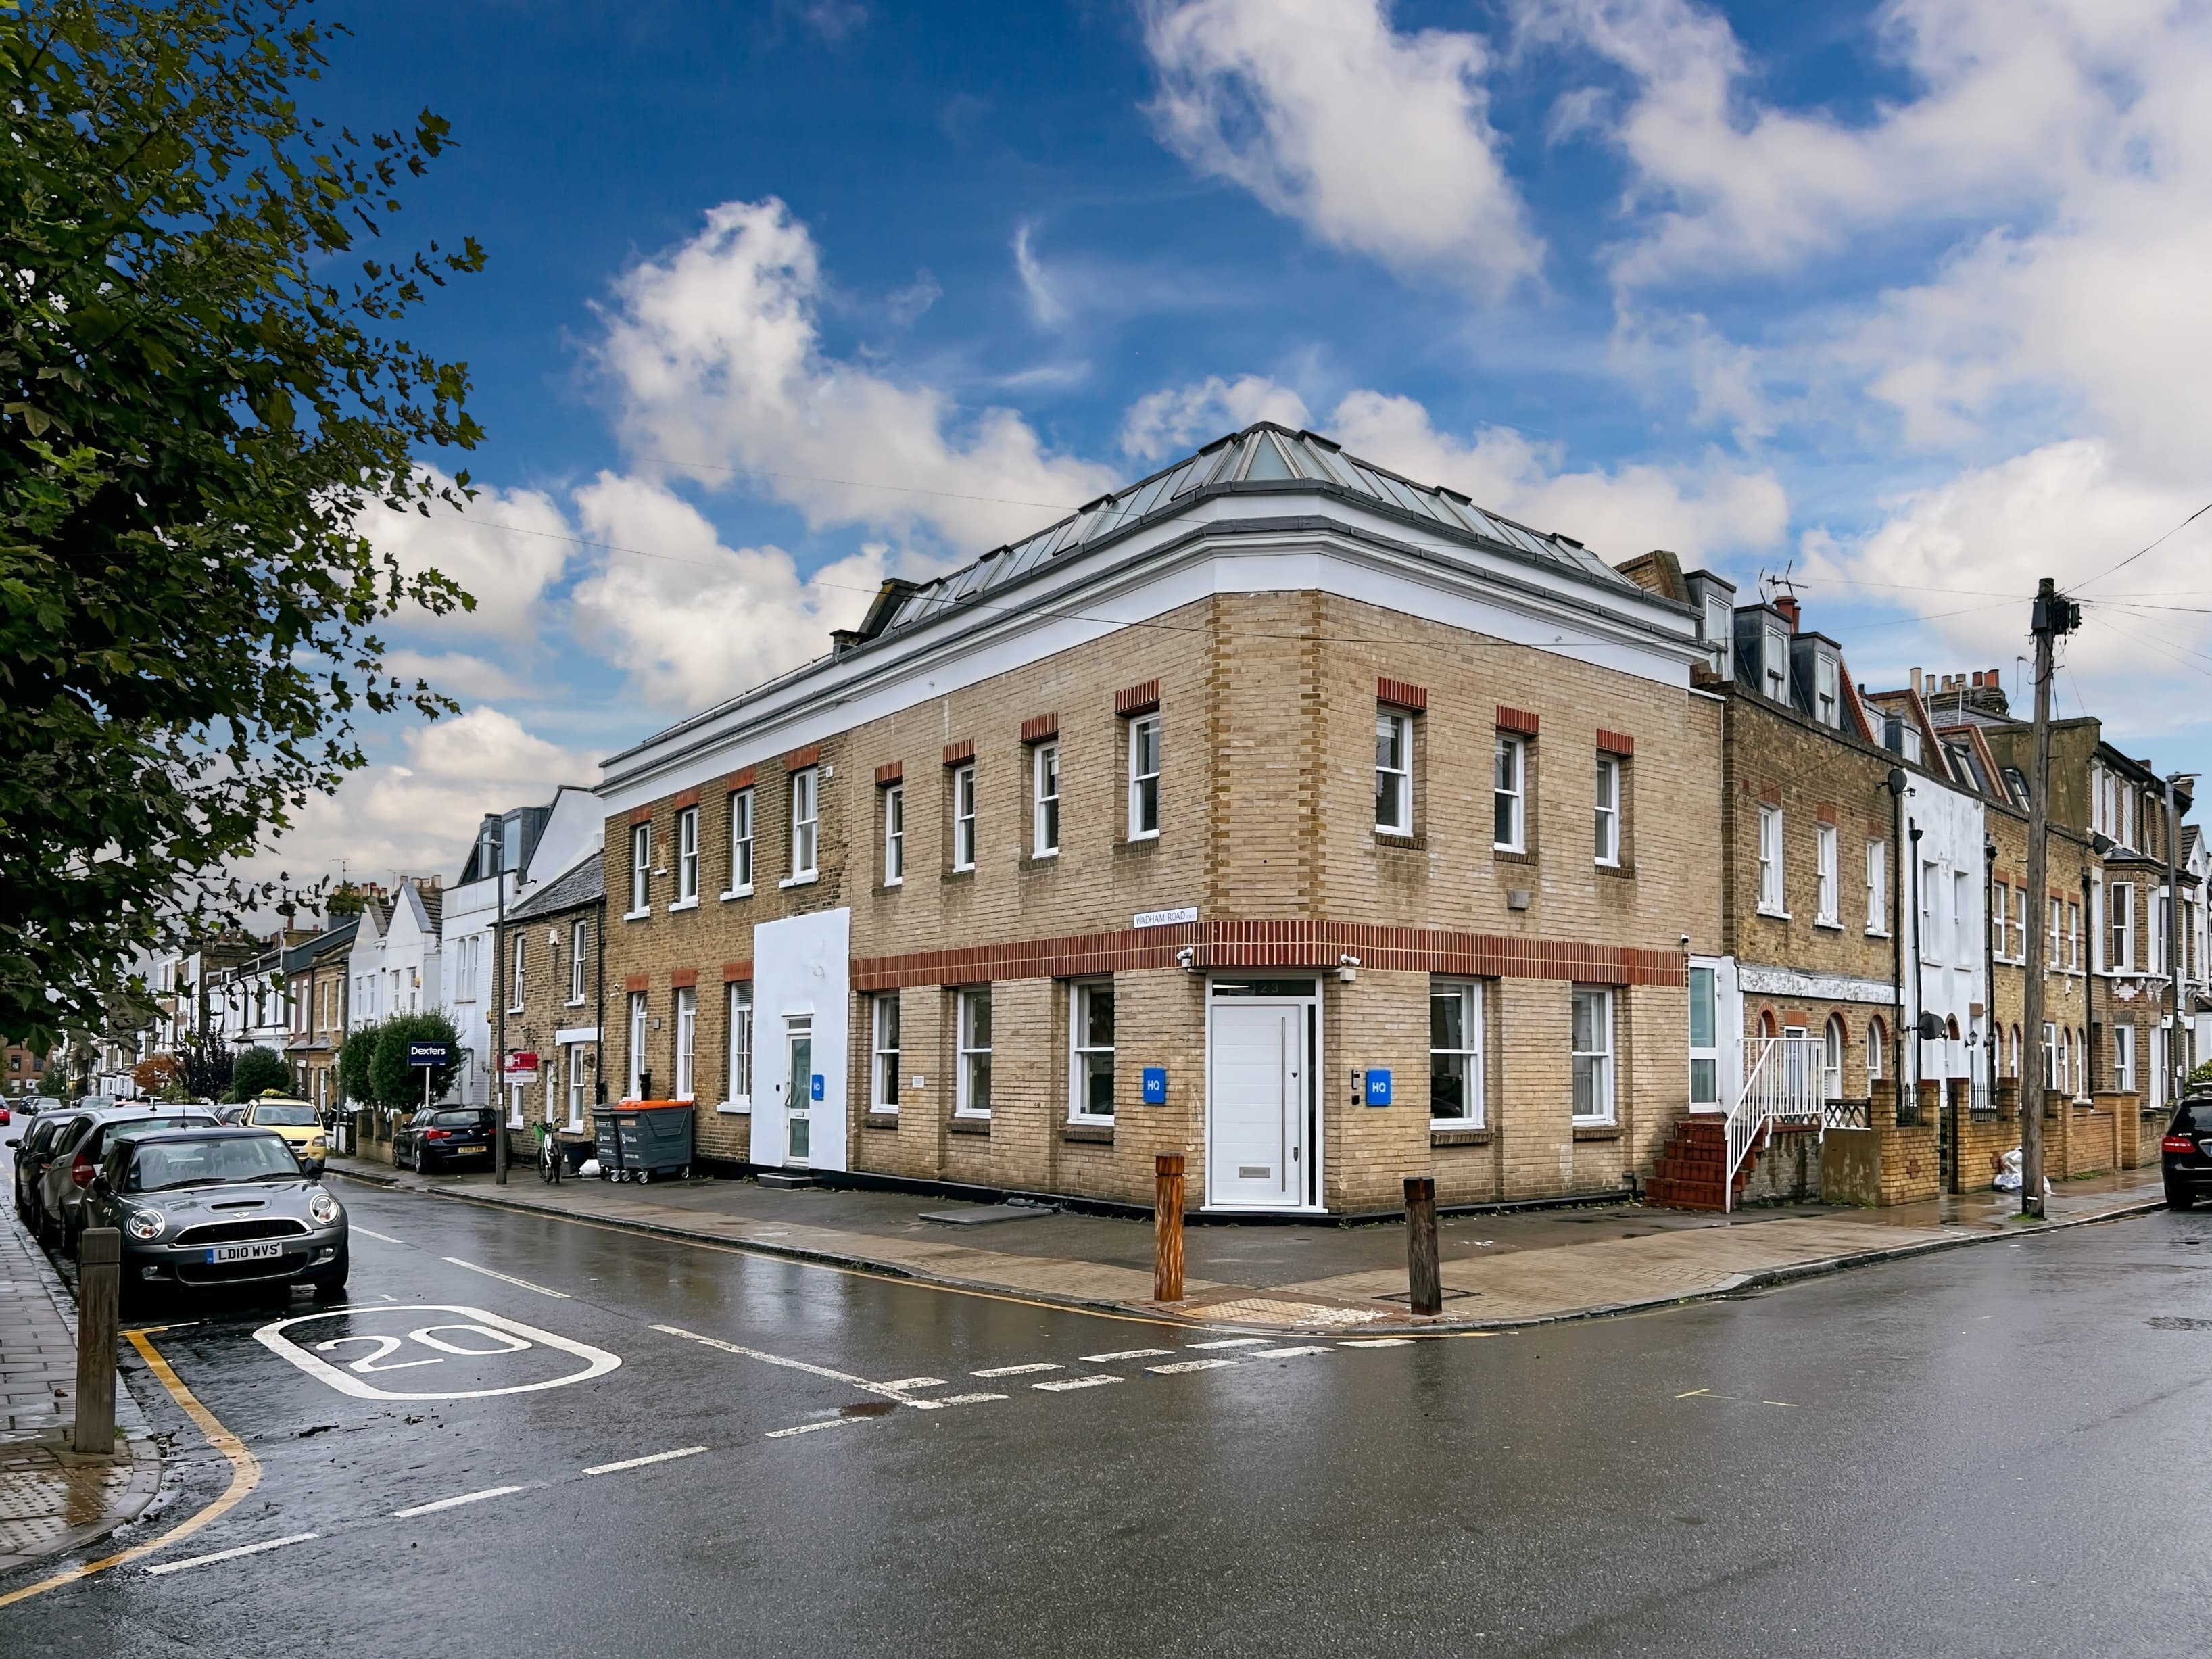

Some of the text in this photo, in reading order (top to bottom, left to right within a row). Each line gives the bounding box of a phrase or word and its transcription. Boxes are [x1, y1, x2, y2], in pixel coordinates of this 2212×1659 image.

[1136, 913, 1165, 925] WADHAM
[1168, 911, 1186, 921] ROAD
[411, 1047, 446, 1055] Dexters
[1147, 1080, 1160, 1091] HQ
[1372, 1082, 1386, 1093] HQ
[218, 1247, 249, 1261] LD10
[253, 1244, 278, 1257] WVS
[316, 1324, 533, 1373] 20
